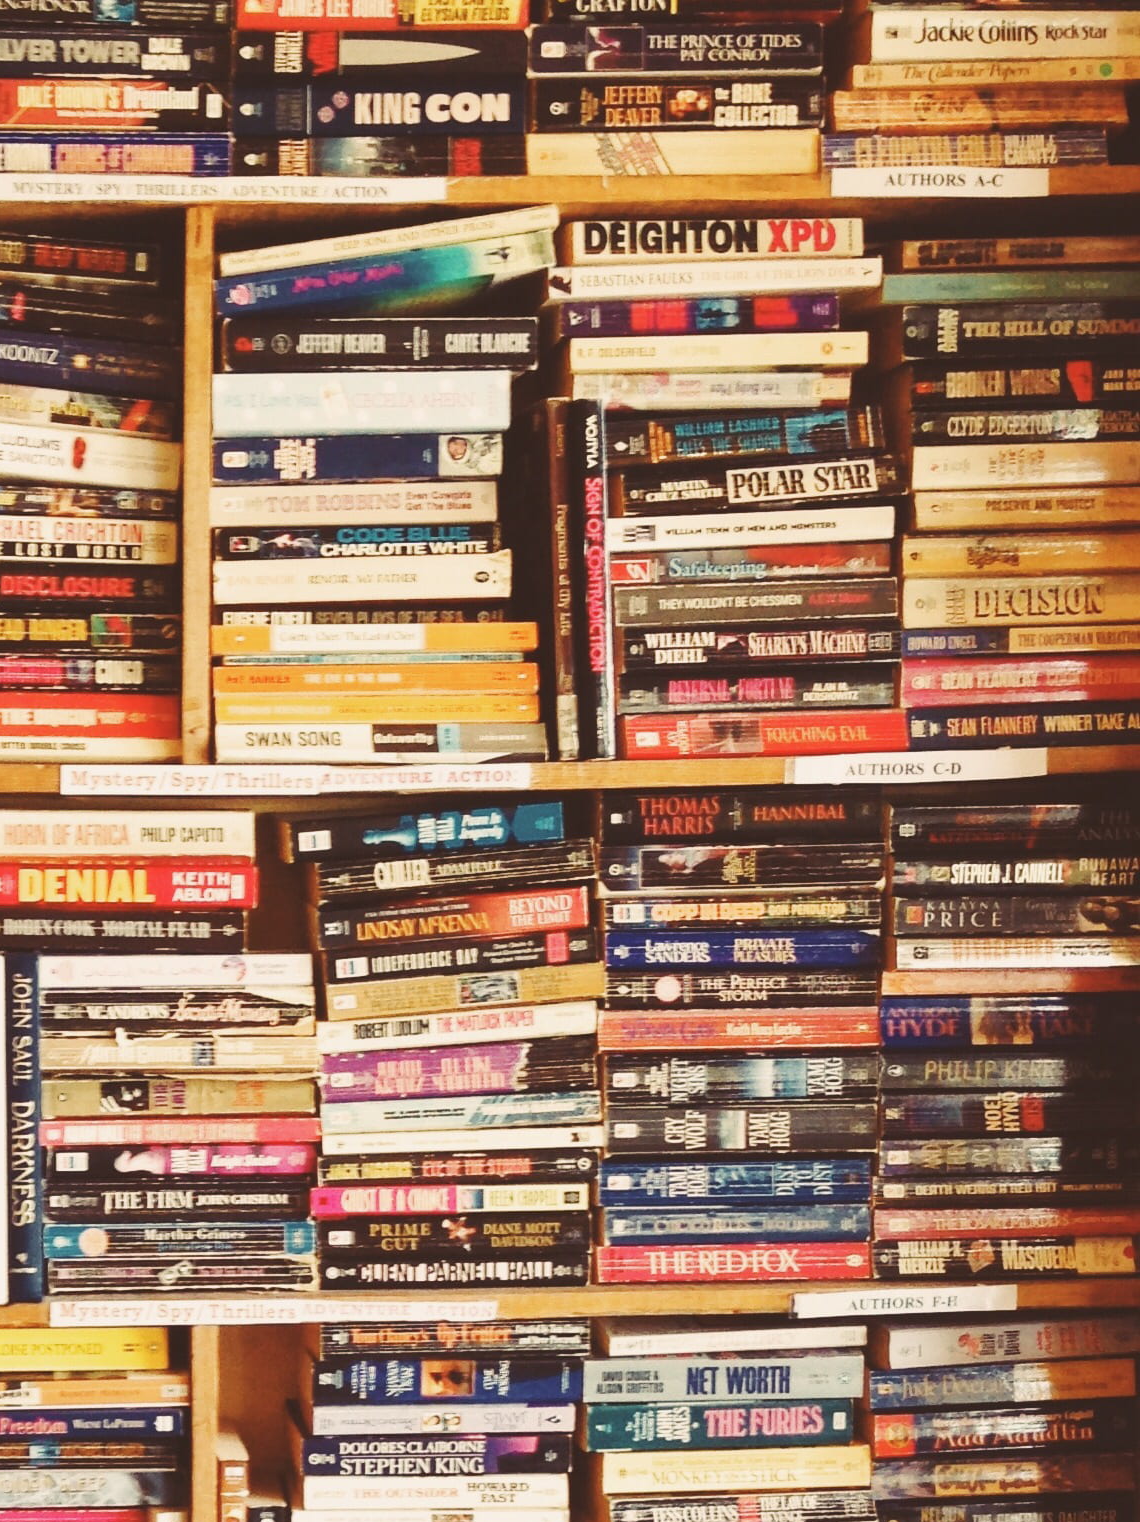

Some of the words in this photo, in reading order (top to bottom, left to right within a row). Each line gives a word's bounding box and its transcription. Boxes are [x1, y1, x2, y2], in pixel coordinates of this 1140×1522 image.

[914, 19, 973, 44] Jackie
[978, 18, 1038, 44] Collins
[1046, 26, 1077, 41] Rock
[1081, 25, 1108, 40] Star
[647, 34, 677, 49] THE
[681, 35, 734, 50] PRINCE
[736, 35, 757, 48] OF
[760, 33, 802, 48] TIDES
[61, 41, 140, 64] TOWER
[680, 49, 707, 62] PAT
[711, 48, 771, 62] CONROY
[601, 87, 662, 107] JEFFERY
[354, 92, 420, 125] KING
[427, 93, 510, 122] CON
[605, 108, 661, 126] DEAVER
[13, 181, 85, 196] MYSTERY
[95, 183, 122, 196] SPY
[136, 184, 218, 197] THRILLERS
[232, 184, 318, 198] ADVENTURE
[333, 184, 389, 198] ACTION
[885, 173, 966, 187] AUTHORS
[974, 173, 1003, 187] A-C
[583, 221, 759, 254] DEIGHTON
[767, 218, 836, 252] XPD
[580, 273, 644, 288] SEBASTIAN
[649, 271, 693, 286] FAULKS
[732, 470, 803, 498] POLAR
[814, 464, 871, 491] STAR
[585, 477, 603, 516] SIGN
[53, 520, 142, 543] CRICHTON
[337, 527, 404, 542] CODE
[408, 527, 470, 541] BLUE
[586, 518, 603, 542] OF
[321, 542, 426, 558] CHARLOTTE
[428, 541, 488, 555] WHITE
[668, 557, 766, 579] Safekeeping
[1, 576, 134, 597] DISCLOSURE
[585, 545, 605, 673] CONTRADICTION
[659, 600, 682, 610] THEY
[685, 598, 731, 609] WOULDN'T
[734, 597, 748, 607] BE
[751, 595, 802, 606] CHESSMEN
[975, 586, 1105, 617] DECISION
[645, 633, 715, 650] WILLIAM
[748, 634, 807, 656] SHARKY'S
[809, 631, 867, 654] MACHINE
[654, 647, 707, 664] DIEHL
[947, 717, 975, 736] SEAN
[979, 715, 1037, 735] FLANNERY
[1043, 713, 1092, 732] WINNER
[1095, 711, 1124, 730] TAKE
[245, 732, 293, 746] SWAN
[299, 732, 342, 746] SONG
[766, 727, 835, 743] TOUCHING
[839, 726, 870, 740] EVIL
[320, 769, 438, 784] ADVENTURE
[846, 762, 924, 776] AUTHORS
[933, 762, 961, 775] C-D
[638, 798, 720, 816] THOMAS
[753, 804, 846, 821] HANNIBAL
[644, 816, 715, 834] HARRIS
[172, 872, 231, 886] KEITH
[951, 865, 1002, 883] STEPHEN
[1015, 864, 1064, 883] CANNELL
[18, 869, 155, 903] DENIAL
[172, 888, 231, 902] ABLOW
[509, 895, 573, 913] BEYOND
[926, 902, 1003, 913] KALAYNA
[924, 912, 1003, 927] PRICE
[734, 938, 794, 951] PRIVATE
[700, 980, 728, 990] THE
[731, 975, 787, 990] PERFECT
[12, 973, 33, 1029] JOHN
[718, 990, 767, 1001] STORM
[11, 1036, 33, 1085] SAUL
[670, 1058, 689, 1103] NIGHT
[691, 1064, 705, 1100] SINS
[808, 1058, 824, 1096] TAMI
[825, 1057, 843, 1096] HOAG
[986, 1092, 1002, 1131] NOEL
[1004, 1091, 1020, 1132] HYND
[664, 1116, 684, 1144] CRY
[686, 1110, 707, 1151] WOLF
[748, 1117, 768, 1147] TAMI
[770, 1111, 791, 1148] HOAG
[11, 1102, 36, 1226] DARKNESS
[101, 1193, 142, 1212] THE
[147, 1192, 194, 1209] FIRM
[369, 1224, 430, 1237] PRIME
[483, 1223, 521, 1235] DIANE
[525, 1223, 560, 1233] MOTT
[644, 1251, 697, 1275] THE
[700, 1251, 748, 1275] RED
[751, 1250, 800, 1273] FOX
[850, 1297, 923, 1311] AUTHORS
[685, 1366, 719, 1395] NET
[728, 1367, 791, 1394] WORTH
[704, 1409, 745, 1437] THE
[749, 1407, 824, 1436] FURIES
[339, 1442, 405, 1455] DOLORES
[407, 1440, 485, 1455] CLAIBORNE
[340, 1459, 429, 1474] STEPHEN
[435, 1459, 484, 1473] KING
[481, 1492, 516, 1503] FAST
